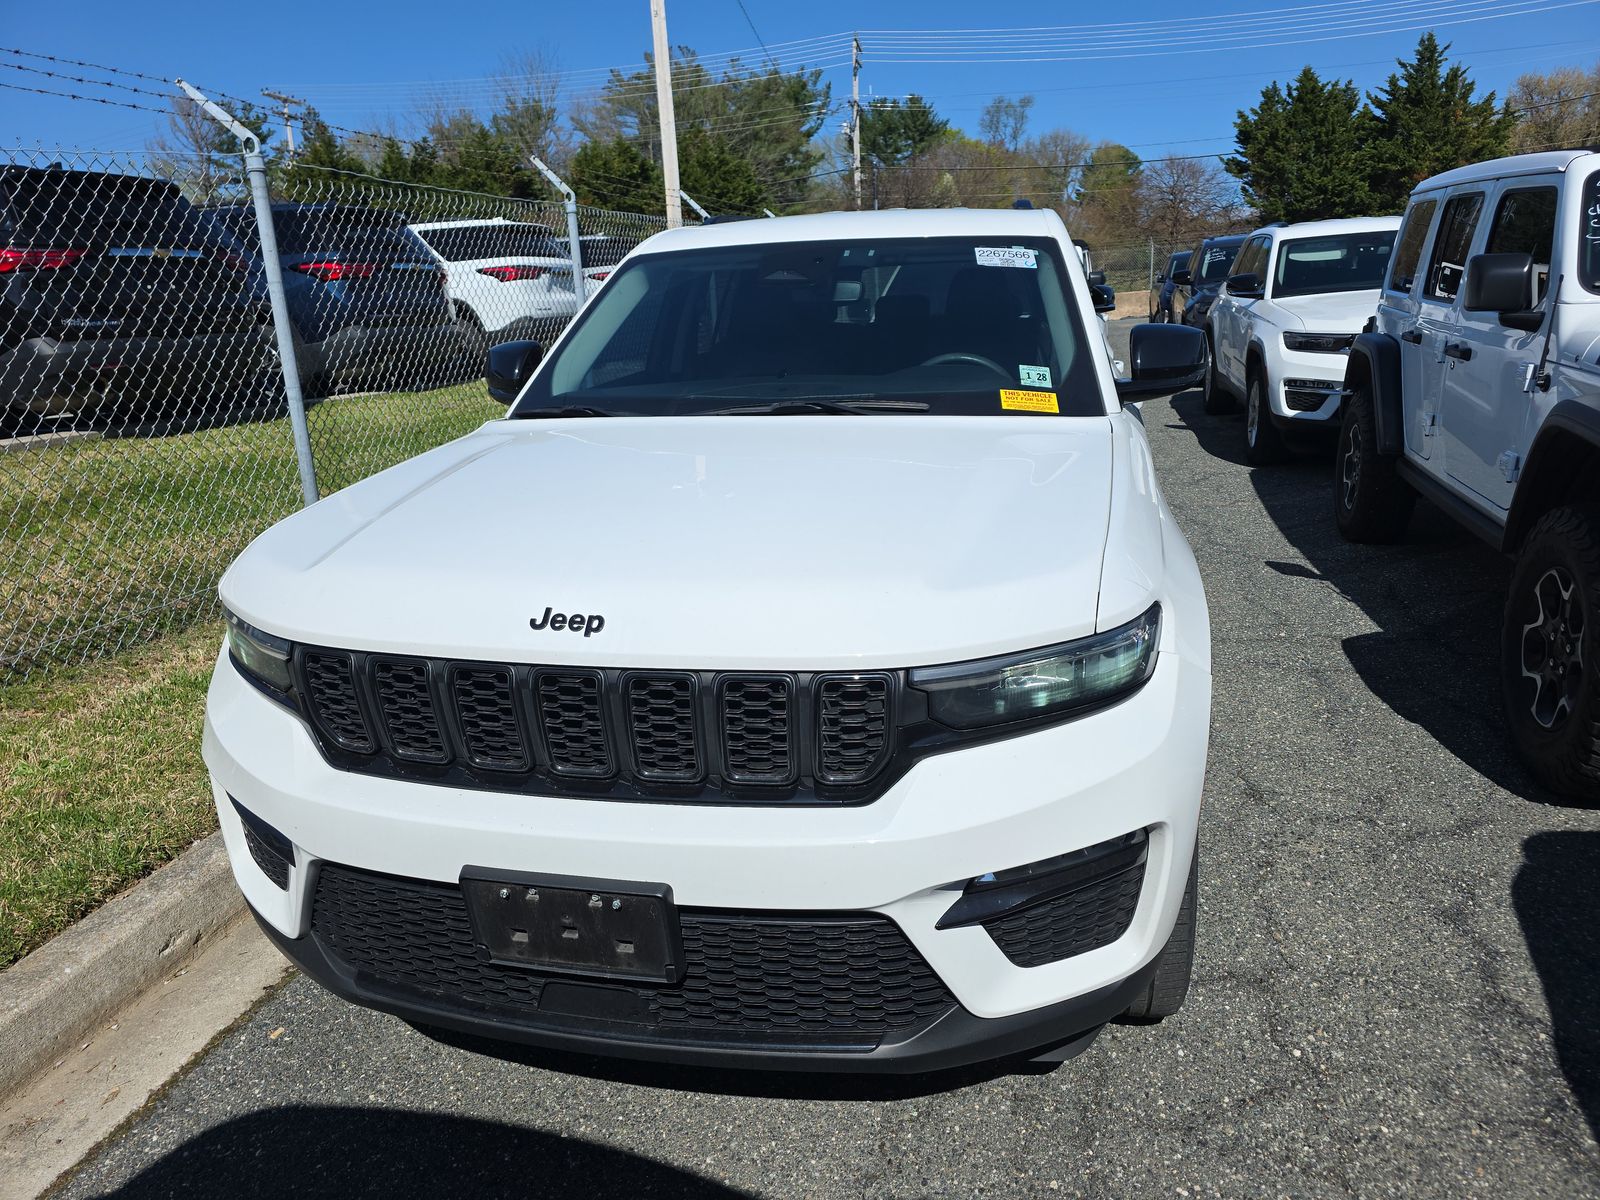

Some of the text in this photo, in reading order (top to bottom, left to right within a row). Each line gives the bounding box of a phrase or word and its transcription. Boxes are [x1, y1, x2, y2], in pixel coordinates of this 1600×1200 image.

[978, 250, 1031, 259] 2267566
[1036, 373, 1048, 381] 28
[529, 606, 605, 638] Jeep
